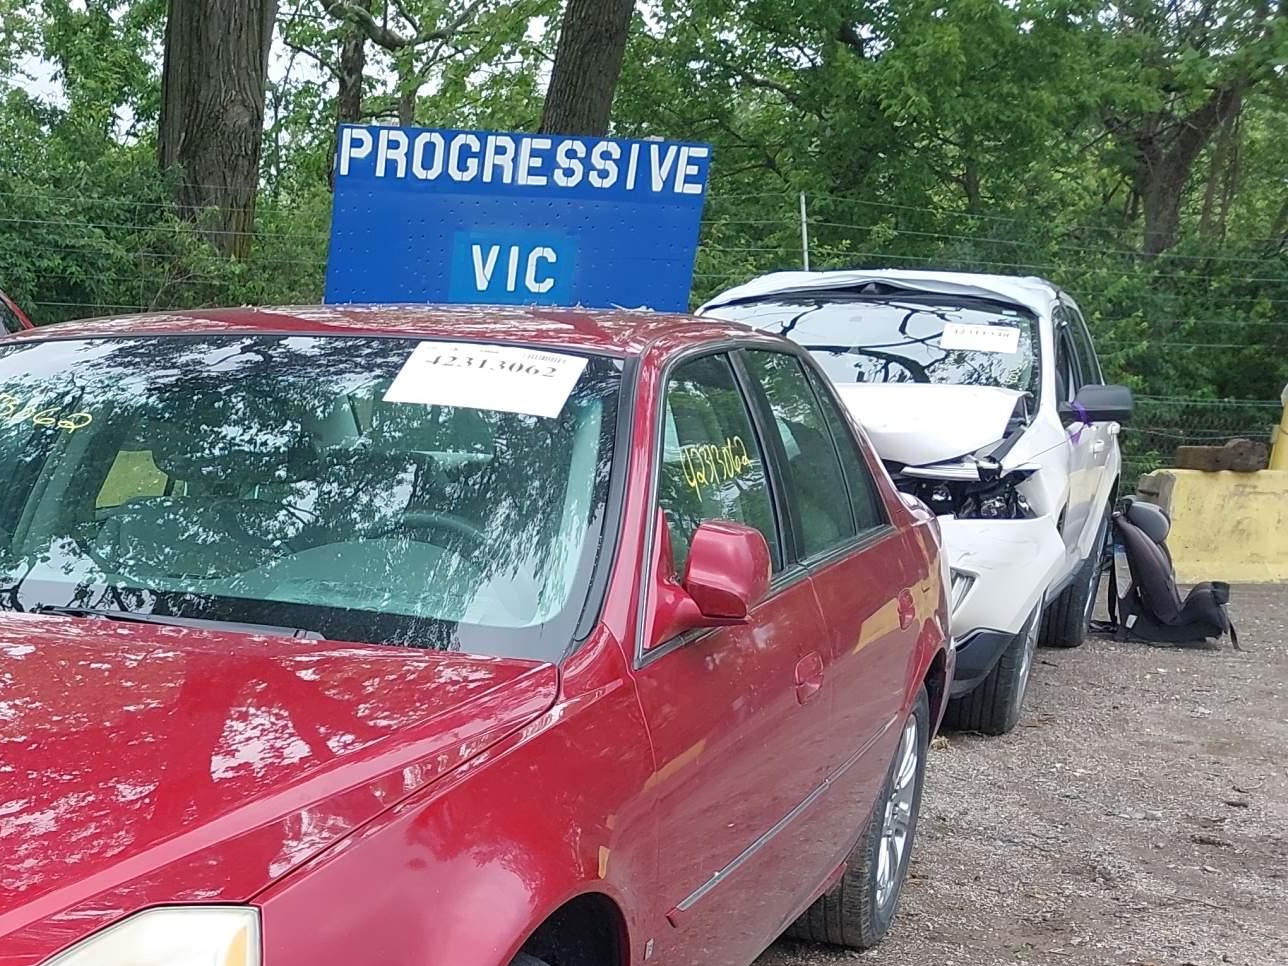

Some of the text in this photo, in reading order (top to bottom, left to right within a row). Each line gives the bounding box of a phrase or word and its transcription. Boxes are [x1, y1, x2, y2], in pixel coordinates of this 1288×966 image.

[338, 127, 710, 195] PROGRESSIVE
[471, 243, 557, 294] VIC
[424, 355, 558, 379] 42313062
